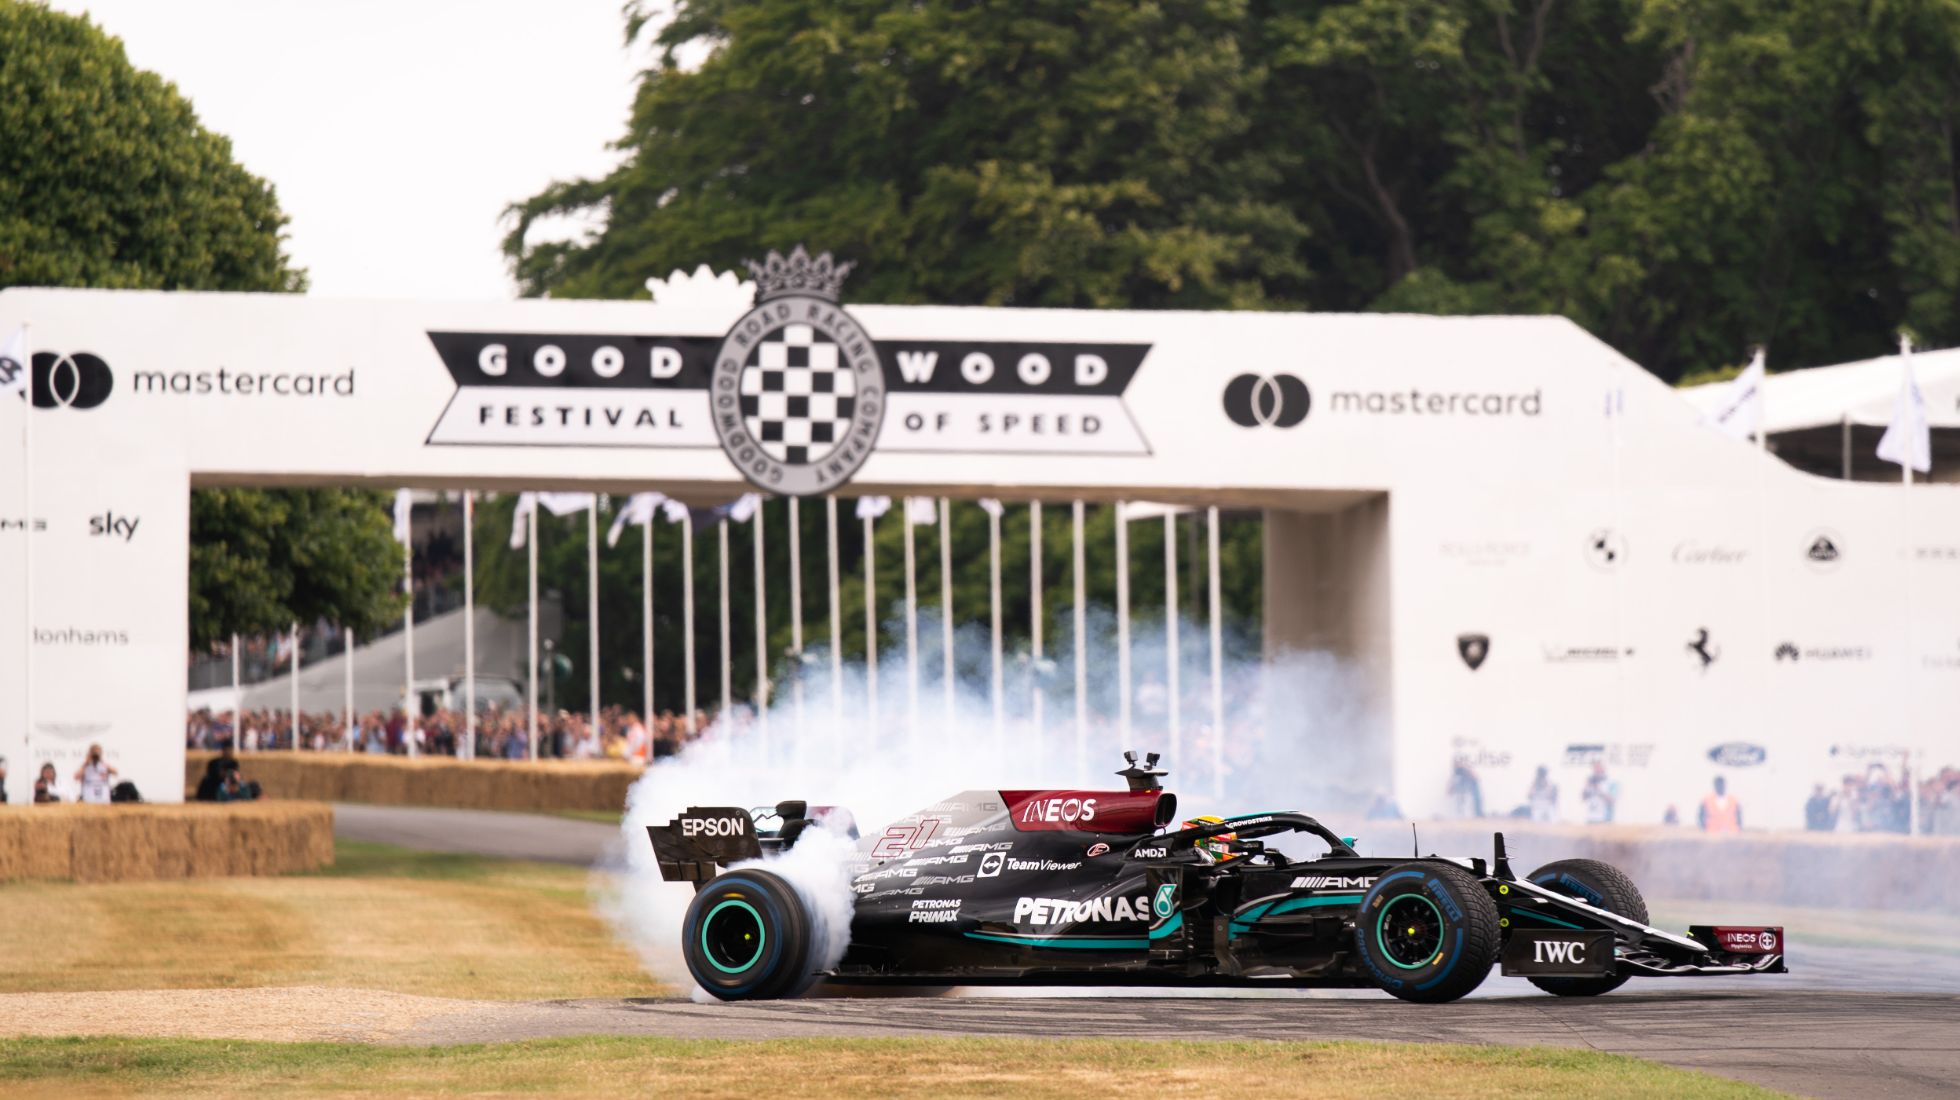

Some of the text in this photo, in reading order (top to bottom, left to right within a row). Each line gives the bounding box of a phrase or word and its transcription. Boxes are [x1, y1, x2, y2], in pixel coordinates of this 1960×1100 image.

[478, 344, 684, 379] GOOD
[896, 350, 1109, 386] WOOD
[133, 366, 356, 396] mastercard
[717, 303, 879, 484] GOODWOOD ROAD RACING COMPANY
[1330, 388, 1543, 416] mastercard
[479, 404, 684, 430] FESTIVAL
[904, 412, 1103, 435] OF SPEED
[89, 510, 140, 542] sky
[1022, 798, 1097, 823] INEOS
[681, 817, 745, 837] EPSON
[871, 819, 940, 858] 21
[1006, 857, 1082, 871] TeamViewer
[1134, 848, 1158, 859] AMD
[908, 908, 961, 923] PRIMAX
[912, 899, 962, 909] PETRONAS
[1013, 896, 1150, 925] PETRONAS
[1727, 933, 1756, 943] INEOS
[1533, 940, 1586, 964] IWC
